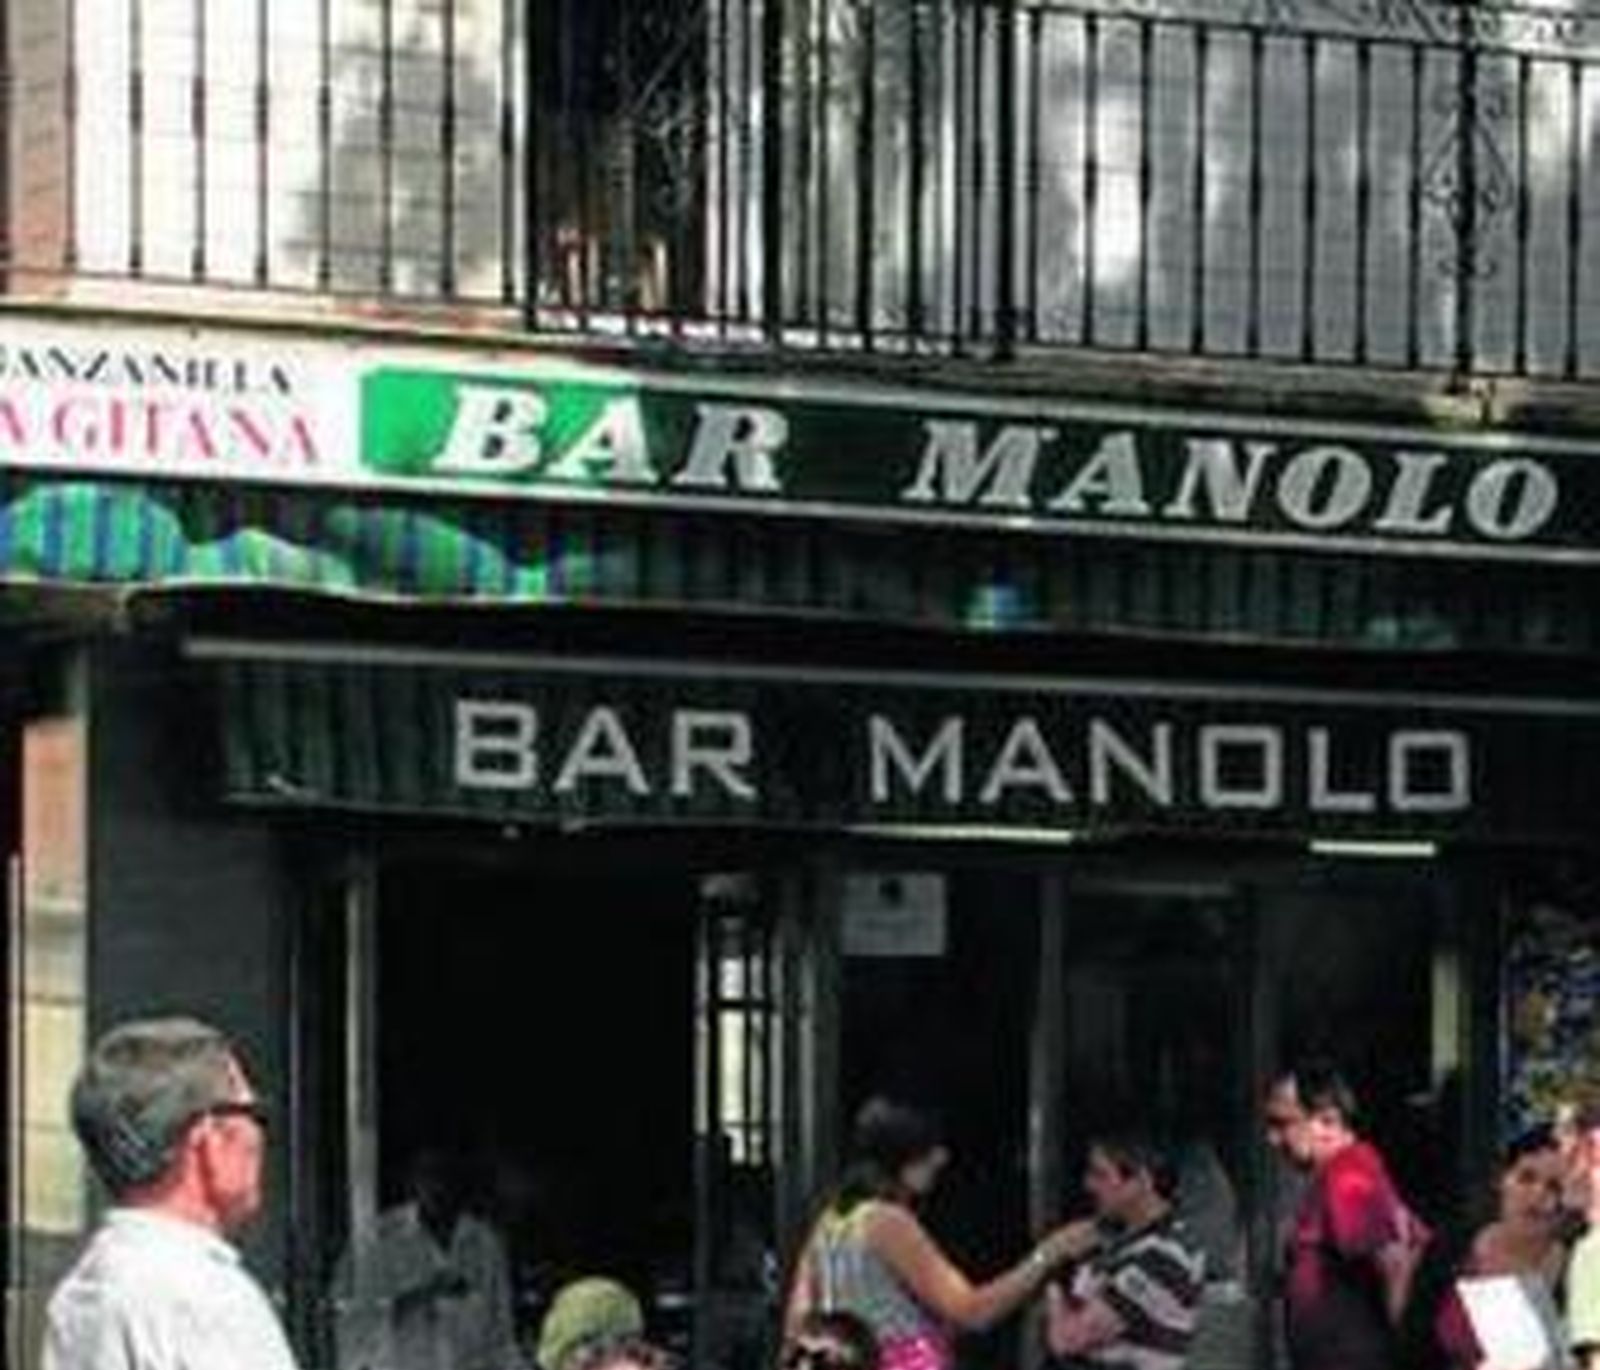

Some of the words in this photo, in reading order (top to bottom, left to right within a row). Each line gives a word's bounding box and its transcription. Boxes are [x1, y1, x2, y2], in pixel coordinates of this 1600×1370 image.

[0, 347, 293, 395] ANZANILLA
[52, 398, 320, 463] GITANA
[431, 382, 789, 491] BAR
[902, 418, 1560, 540] MANOLO
[453, 699, 756, 799] BAR
[868, 714, 1472, 813] MANOLO
